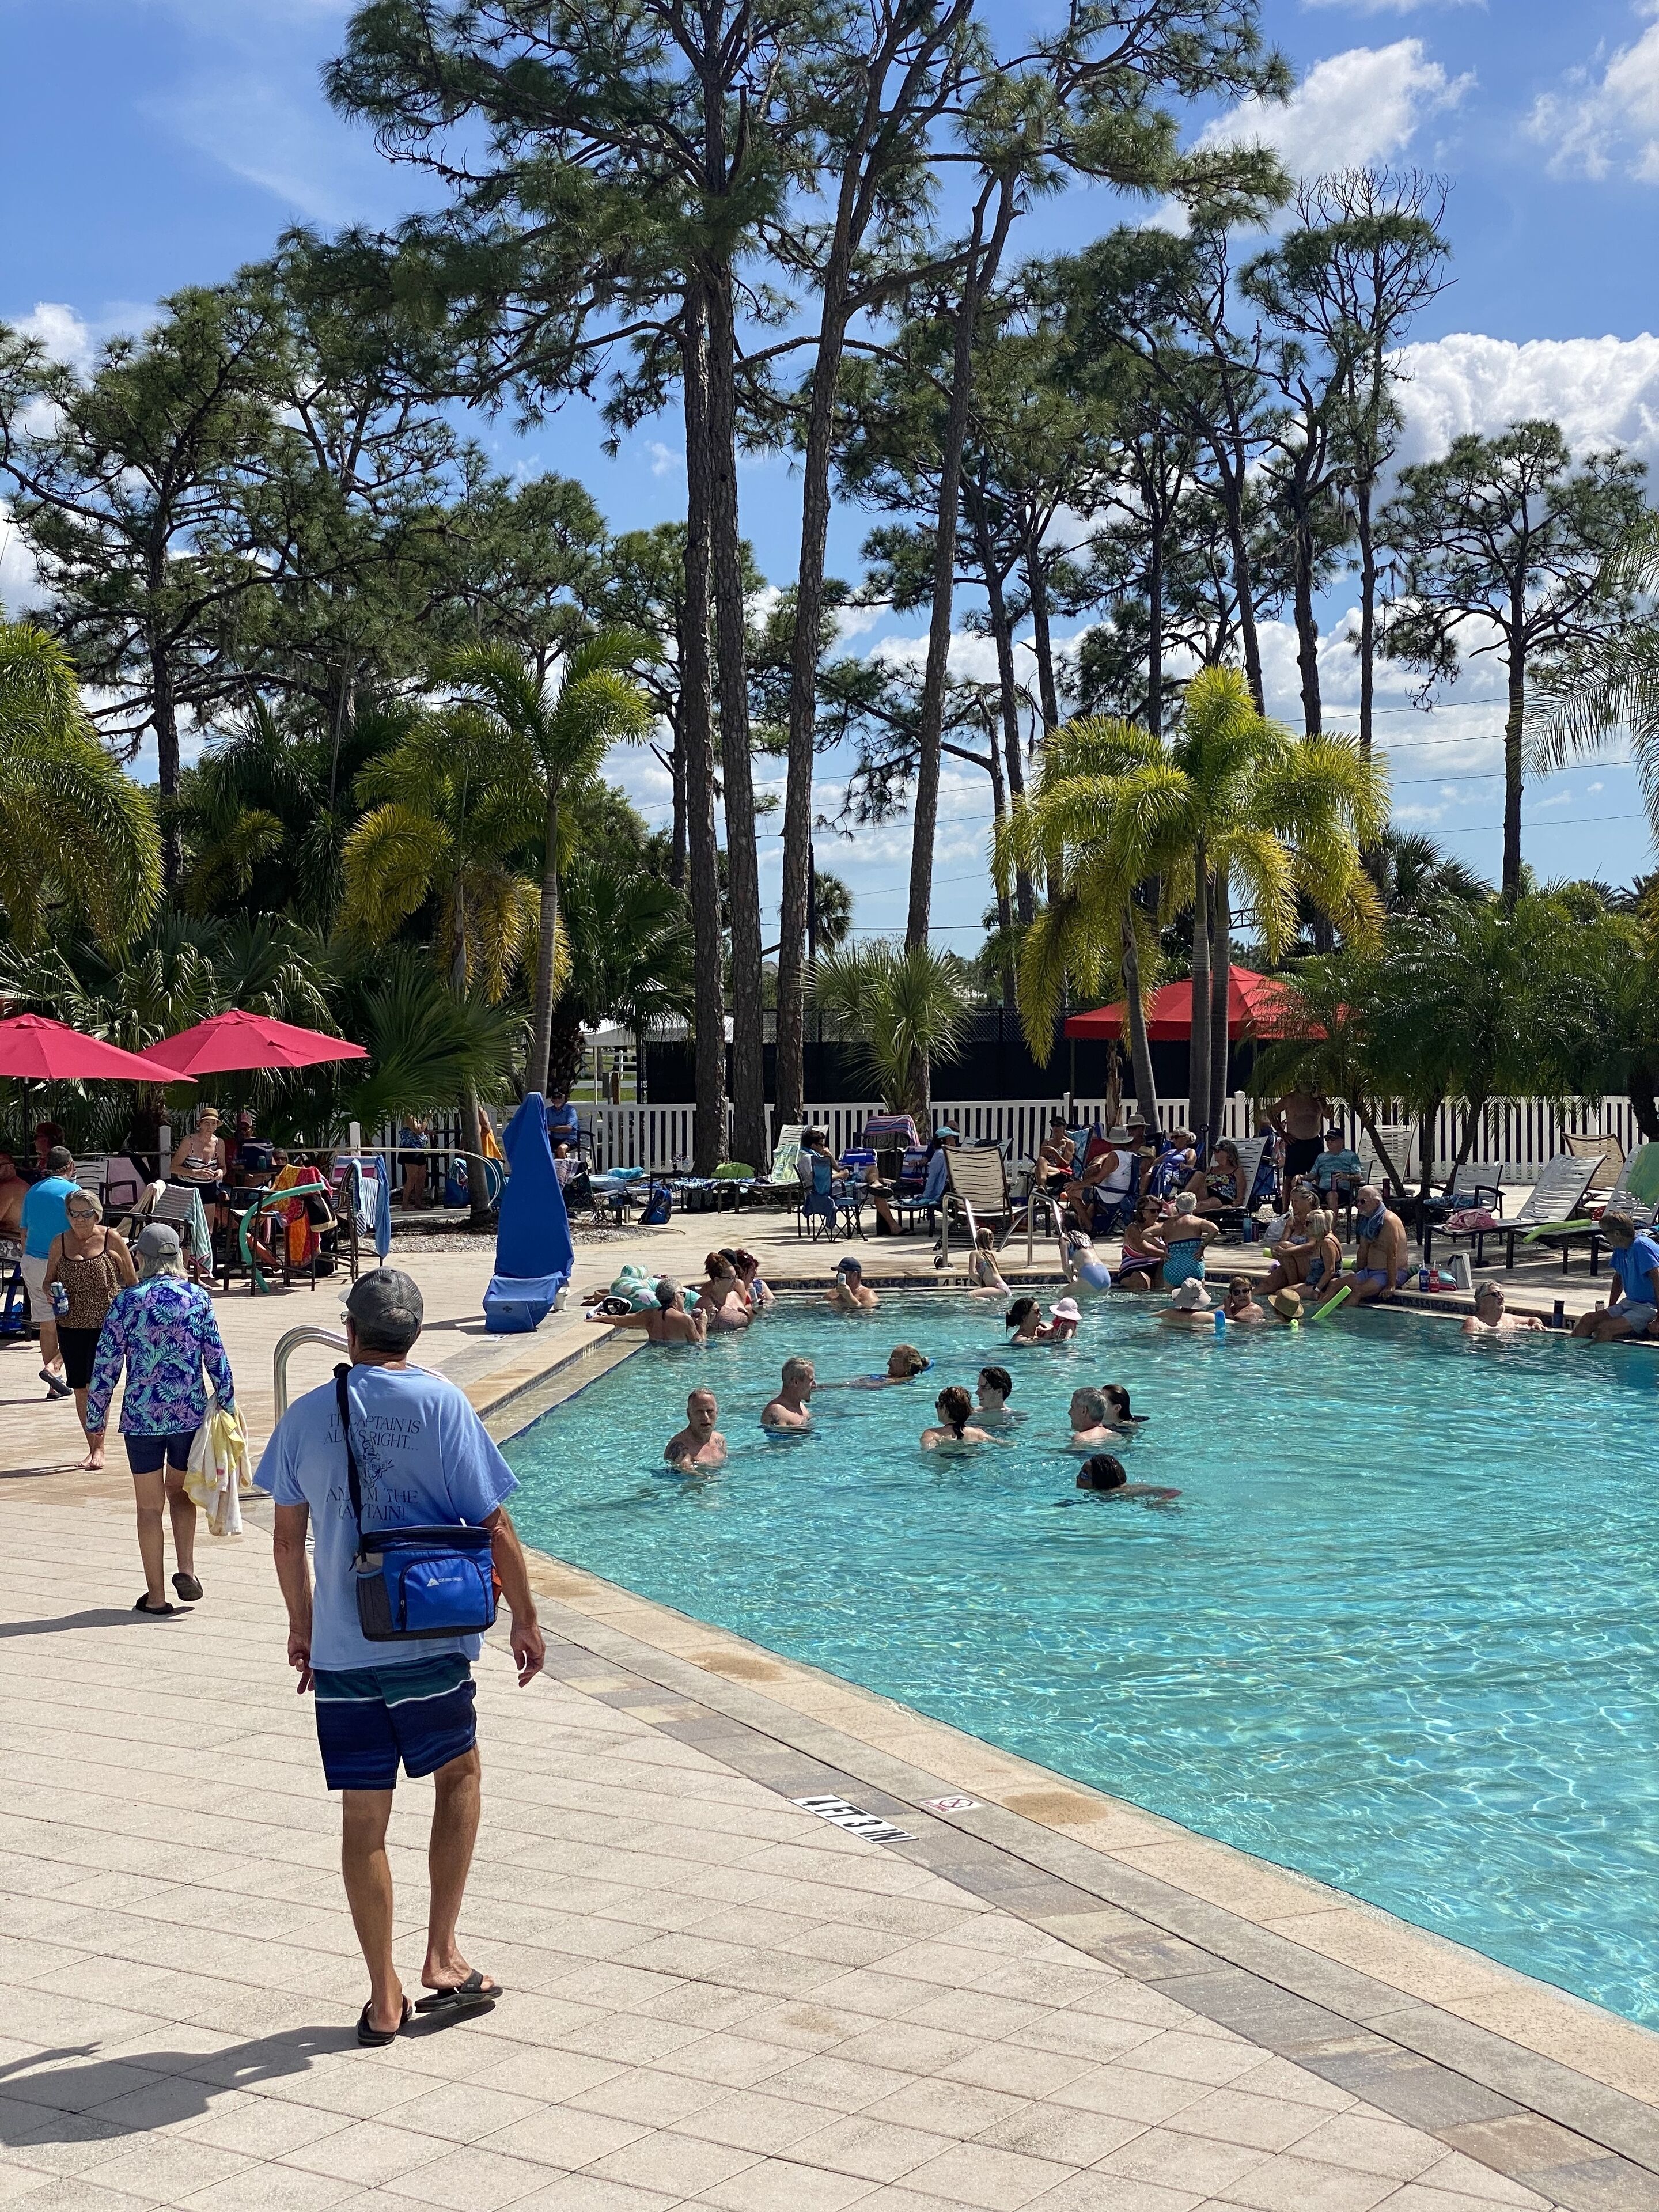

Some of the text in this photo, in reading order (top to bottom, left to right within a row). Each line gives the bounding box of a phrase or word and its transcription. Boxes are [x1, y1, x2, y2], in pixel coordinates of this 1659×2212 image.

[955, 1278, 969, 1286] FT
[350, 1412, 404, 1432] CAPTAIN
[407, 1419, 421, 1434] IS
[384, 1488, 419, 1505] THE
[815, 1806, 869, 1818] FT
[858, 1828, 912, 1842] IN
